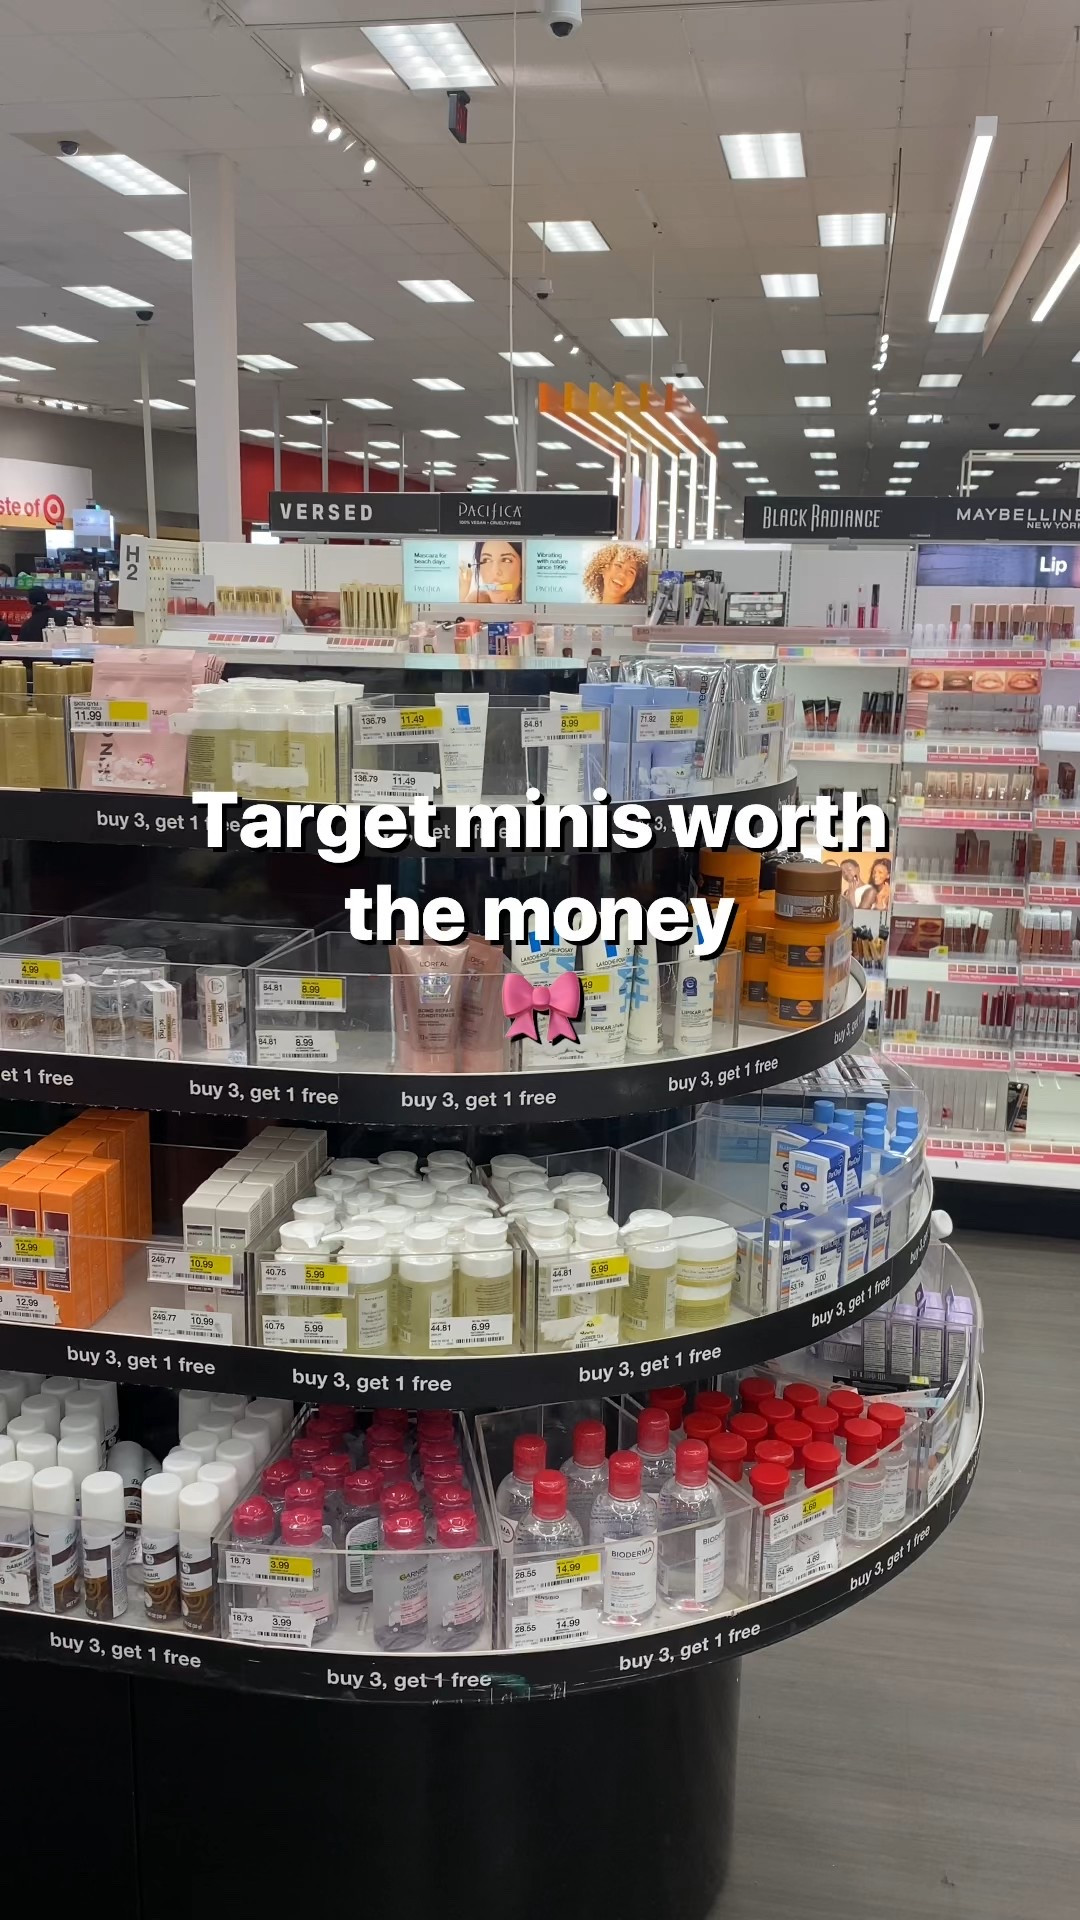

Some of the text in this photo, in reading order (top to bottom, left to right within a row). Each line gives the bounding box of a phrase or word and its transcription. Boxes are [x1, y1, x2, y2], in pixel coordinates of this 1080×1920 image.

[24, 497, 41, 517] of
[280, 502, 373, 521] VERSED
[458, 501, 522, 519] PACIFICA
[763, 504, 881, 532] BLACK RADIANCE
[126, 545, 139, 563] H
[537, 552, 563, 560] Vibrating
[126, 563, 138, 581] 2
[1040, 556, 1067, 575] Lip
[75, 711, 102, 720] 11.99
[361, 715, 425, 725] 136.79 11.49
[561, 719, 579, 728] 8.99
[354, 775, 416, 786] 136.79 11.49
[97, 811, 198, 832] buy 3, get 1
[21, 965, 39, 974] 4.99
[263, 984, 320, 994] 84.81 8.99
[295, 1038, 314, 1047] 8.99
[24, 1069, 74, 1086] 1 free
[668, 1056, 779, 1092] buy 3, get 1 free
[190, 1080, 339, 1105] buy 3, get 1 free
[401, 1091, 557, 1111] buy 3, get 1 free
[16, 1243, 38, 1251] 12.99
[151, 1255, 214, 1268] 249.77 10.99
[265, 1268, 325, 1278] 40.75 5.99
[552, 1264, 609, 1277] 44.81 6.99
[16, 1298, 39, 1307] 12.99
[811, 1275, 891, 1328] buy 3, get 1 free
[152, 1312, 214, 1326] 249.77 10.99
[264, 1322, 324, 1333] 40.75 5.99
[430, 1322, 490, 1332] 44.81 6.99
[67, 1345, 216, 1375] buy 3, get 1 free
[579, 1345, 722, 1383] buy 3, get 1 free
[292, 1368, 452, 1393] buy 3, get 1 free
[802, 1502, 817, 1514] 4.69
[773, 1514, 789, 1527] 24.95
[611, 1546, 652, 1558] BIODERMA
[806, 1553, 820, 1565] 4.69
[850, 1525, 931, 1592] buy 3, get 1 free
[230, 1557, 290, 1570] 18.73 3.99
[515, 1563, 581, 1579] 28.55 14.99
[232, 1614, 292, 1627] 18.73 3.99
[515, 1618, 580, 1634] 28.55 14.99
[50, 1631, 201, 1668] buy 3, get 1 free
[619, 1622, 761, 1672] buy 3, get 1 free
[327, 1668, 492, 1691] buy 3, get 1 free
